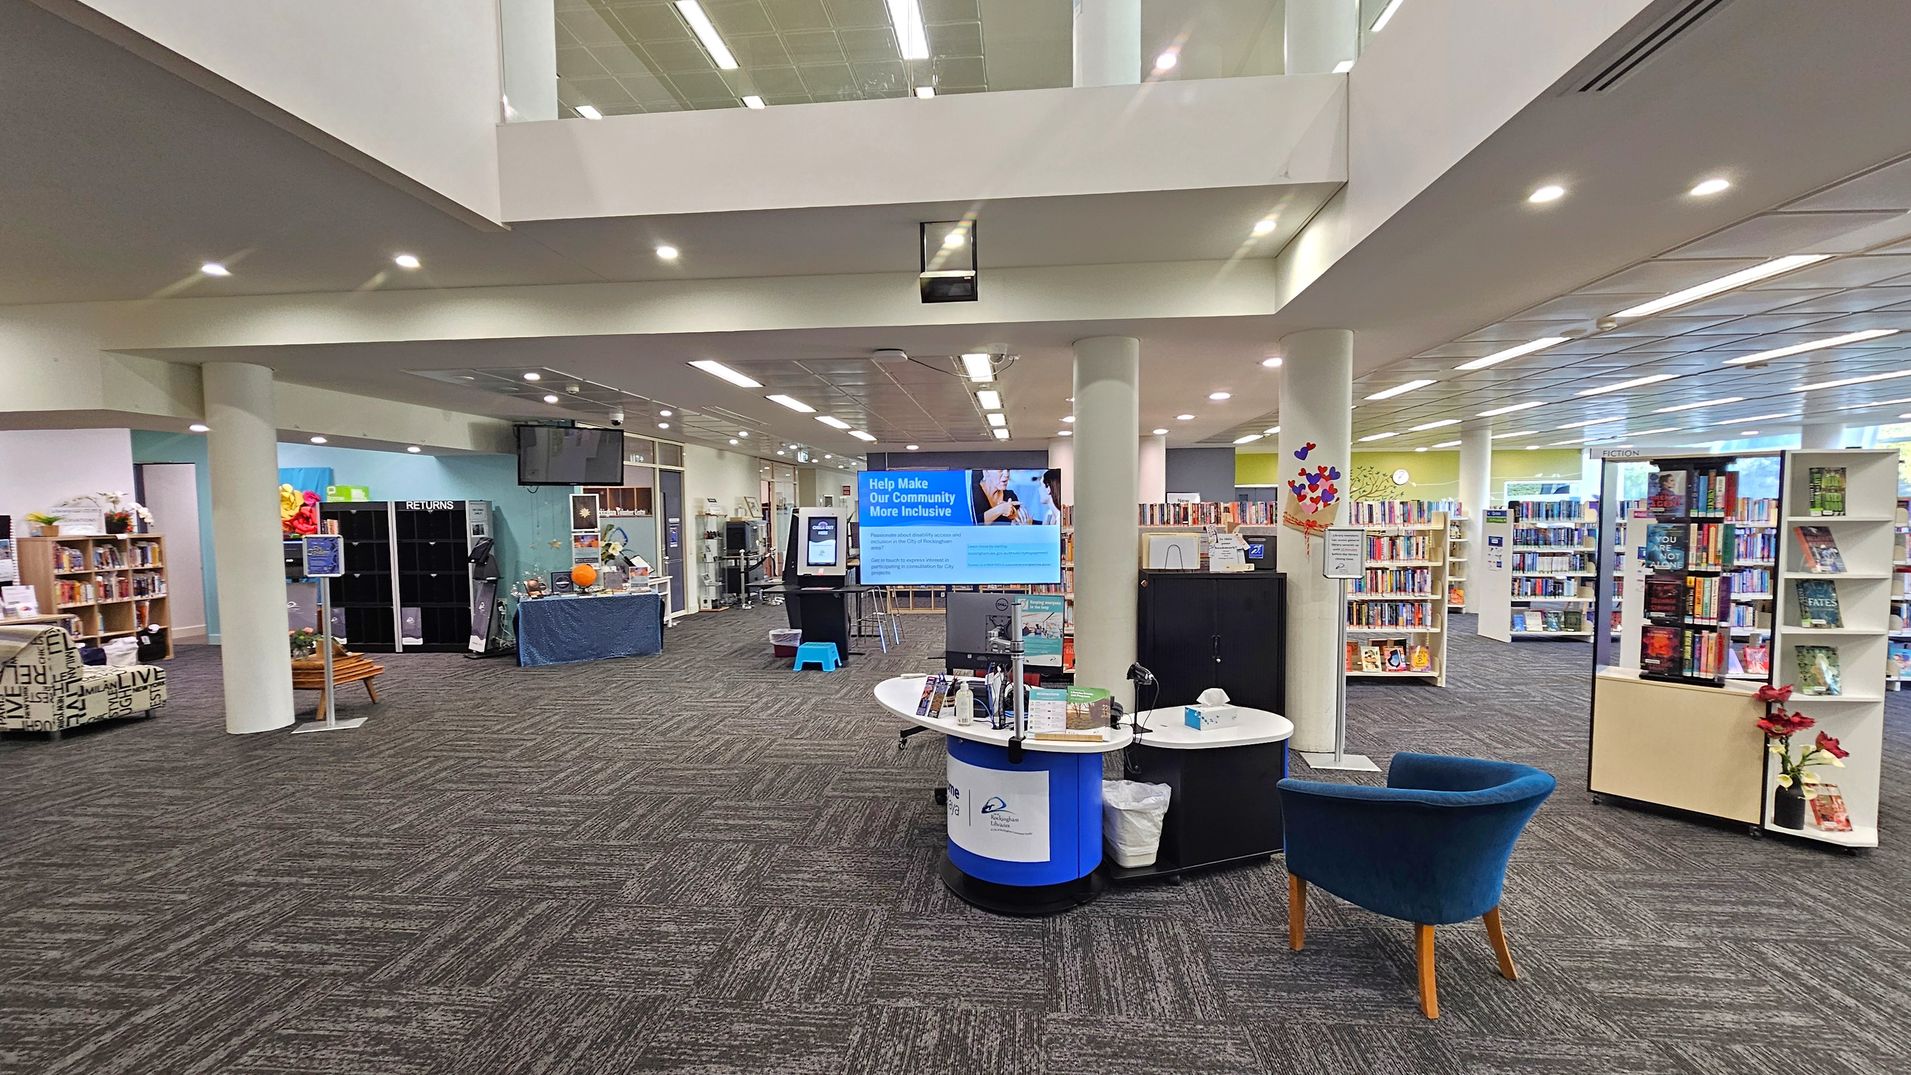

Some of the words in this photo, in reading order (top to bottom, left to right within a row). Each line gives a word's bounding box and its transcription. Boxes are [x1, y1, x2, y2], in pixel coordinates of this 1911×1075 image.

[869, 478, 895, 492] Help
[898, 477, 928, 489] Make
[869, 492, 889, 503] Our
[893, 491, 955, 505] Community
[406, 501, 454, 510] RETURNS
[870, 505, 898, 517] More
[901, 504, 951, 517] Inclusive
[1653, 544, 1672, 552] ARE
[1650, 561, 1683, 569] ALONE
[1808, 598, 1838, 607] FATES
[117, 668, 166, 690] LIVE
